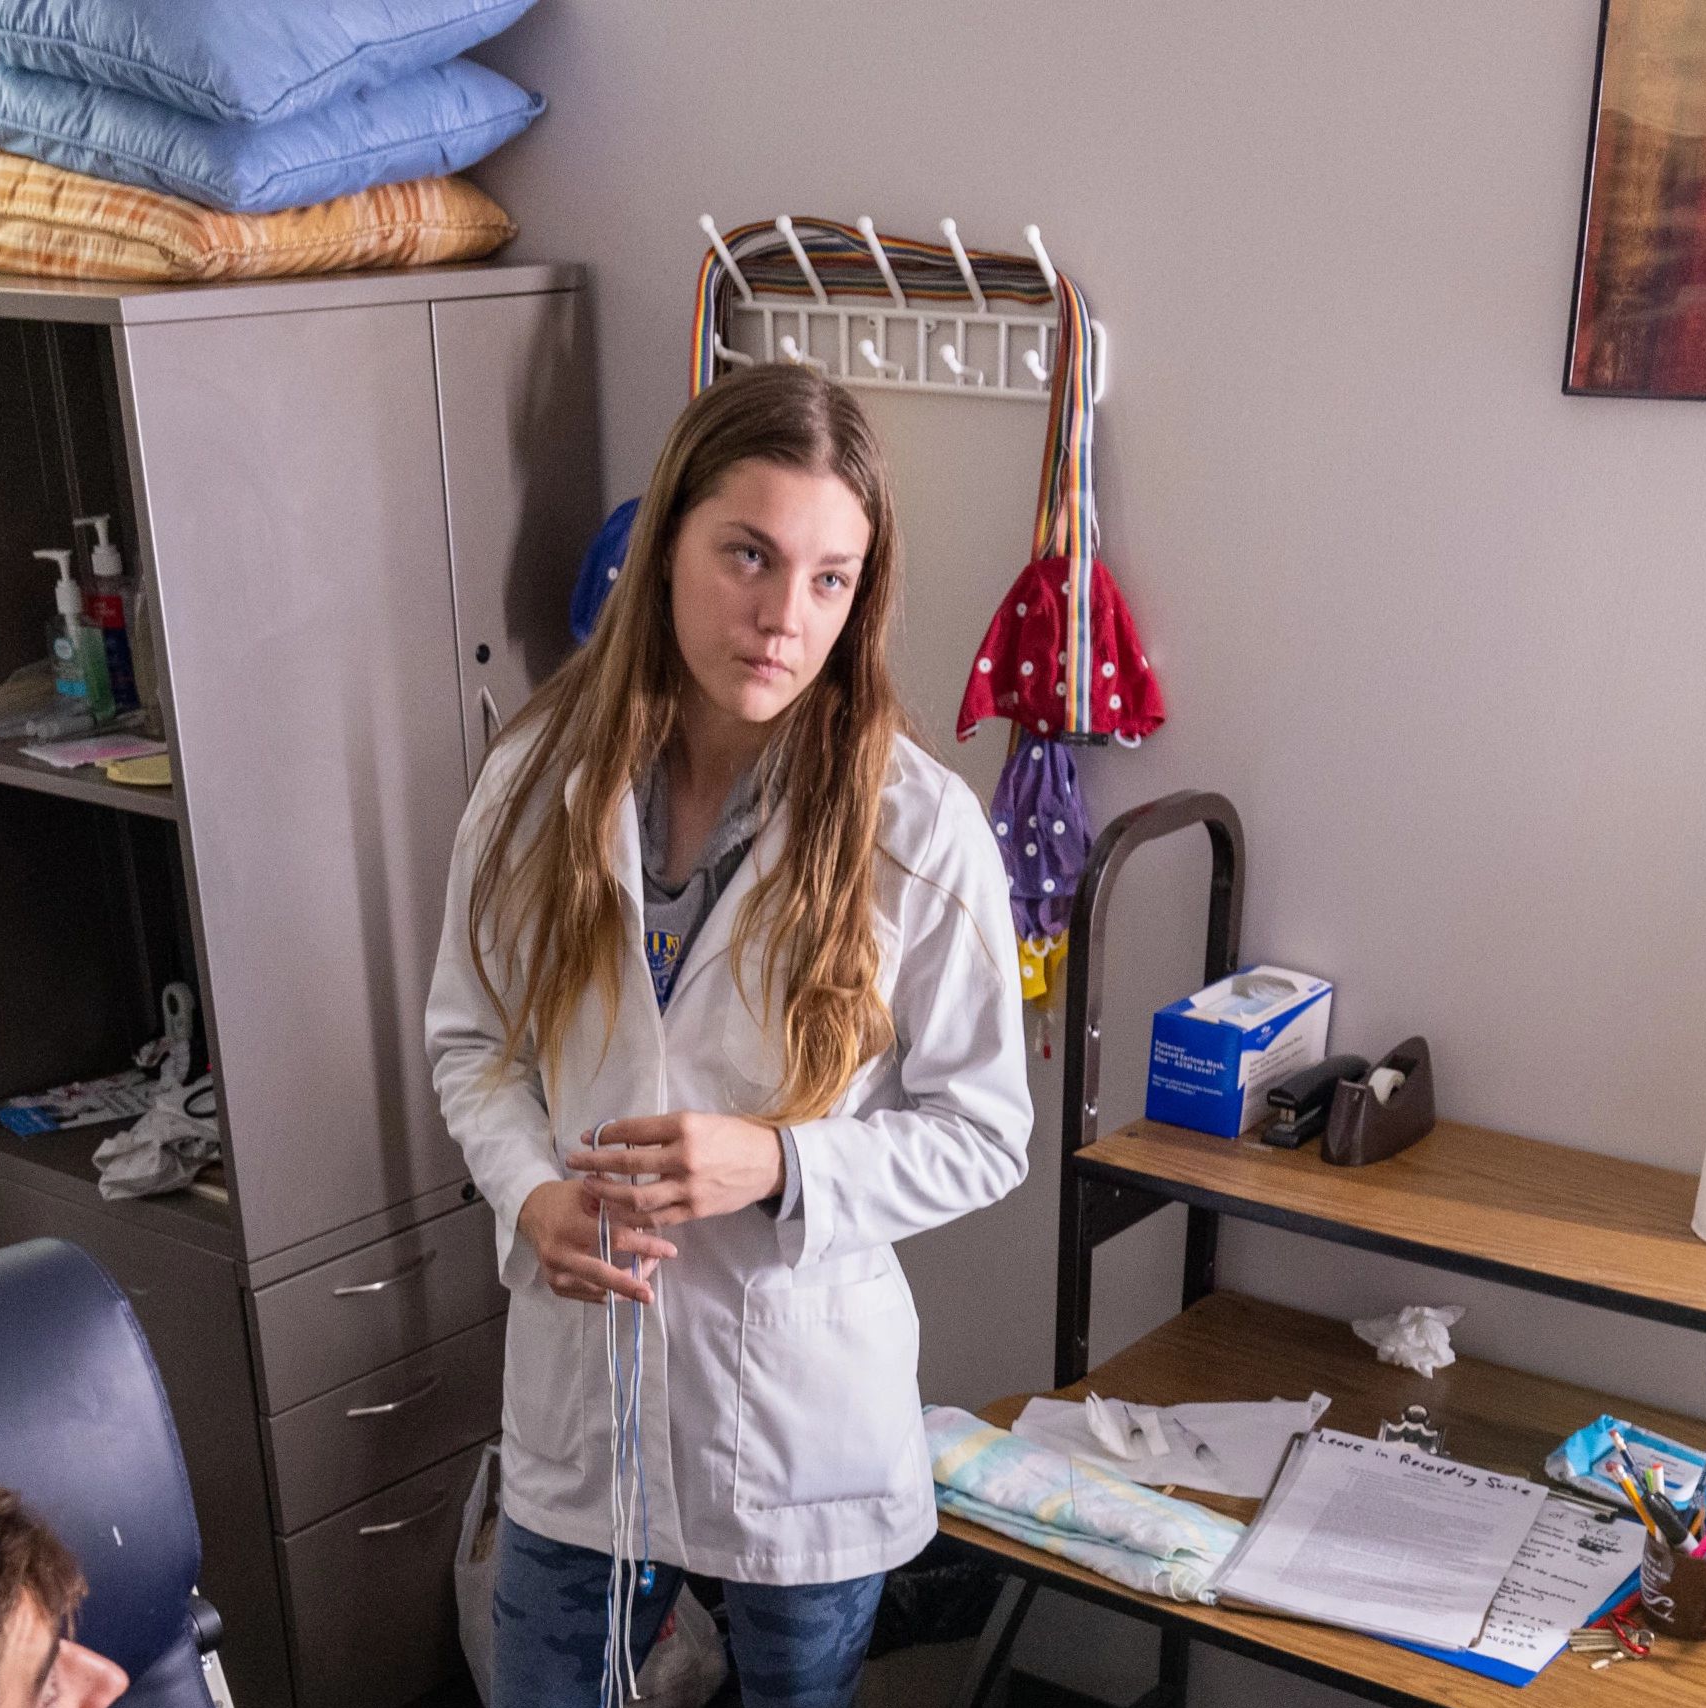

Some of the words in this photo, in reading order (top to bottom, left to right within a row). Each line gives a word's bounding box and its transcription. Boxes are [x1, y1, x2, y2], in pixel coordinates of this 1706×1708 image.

[1318, 1433, 1363, 1452] Leave
[1375, 1449, 1388, 1459] in
[1399, 1453, 1477, 1487] Recording
[1485, 1476, 1532, 1496] Suite
